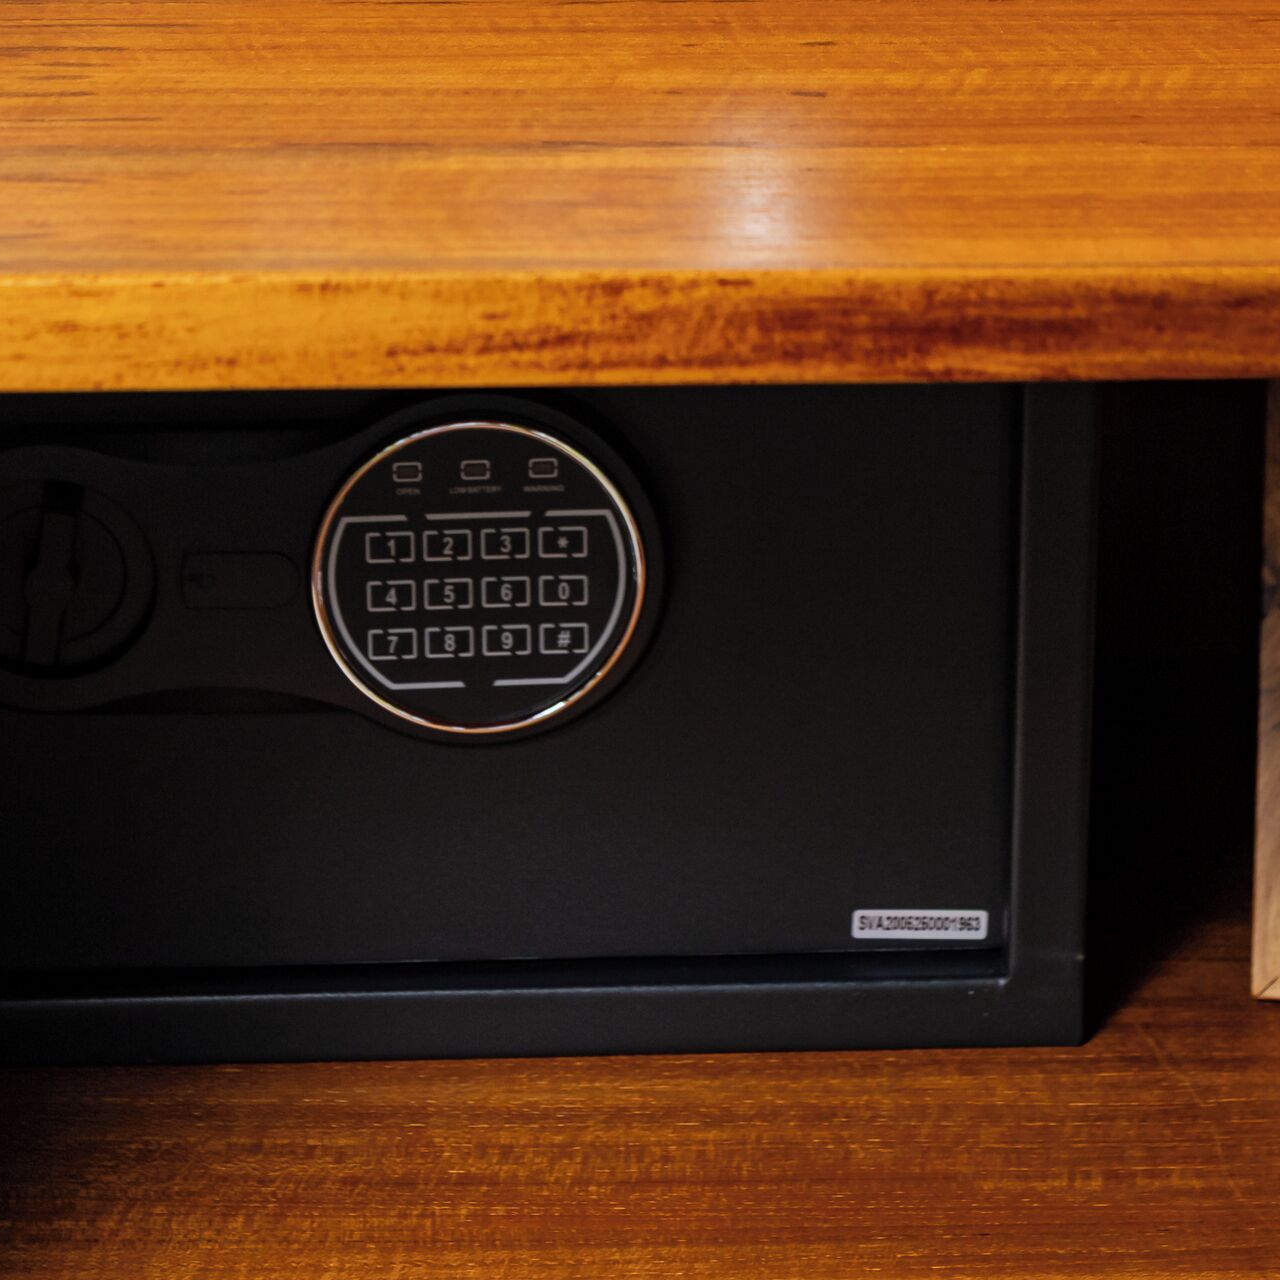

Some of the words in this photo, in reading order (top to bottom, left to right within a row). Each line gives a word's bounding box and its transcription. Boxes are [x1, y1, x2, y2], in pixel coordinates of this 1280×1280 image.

[395, 487, 421, 496] OPEN
[386, 538, 396, 557] 1
[442, 536, 454, 556] 2
[500, 535, 512, 553] 3
[385, 586, 398, 606] 4
[443, 584, 456, 604] 5
[500, 583, 513, 602] 6
[558, 581, 570, 600] 0
[387, 635, 399, 654] 7
[444, 633, 456, 652] 8
[501, 631, 514, 650] 9
